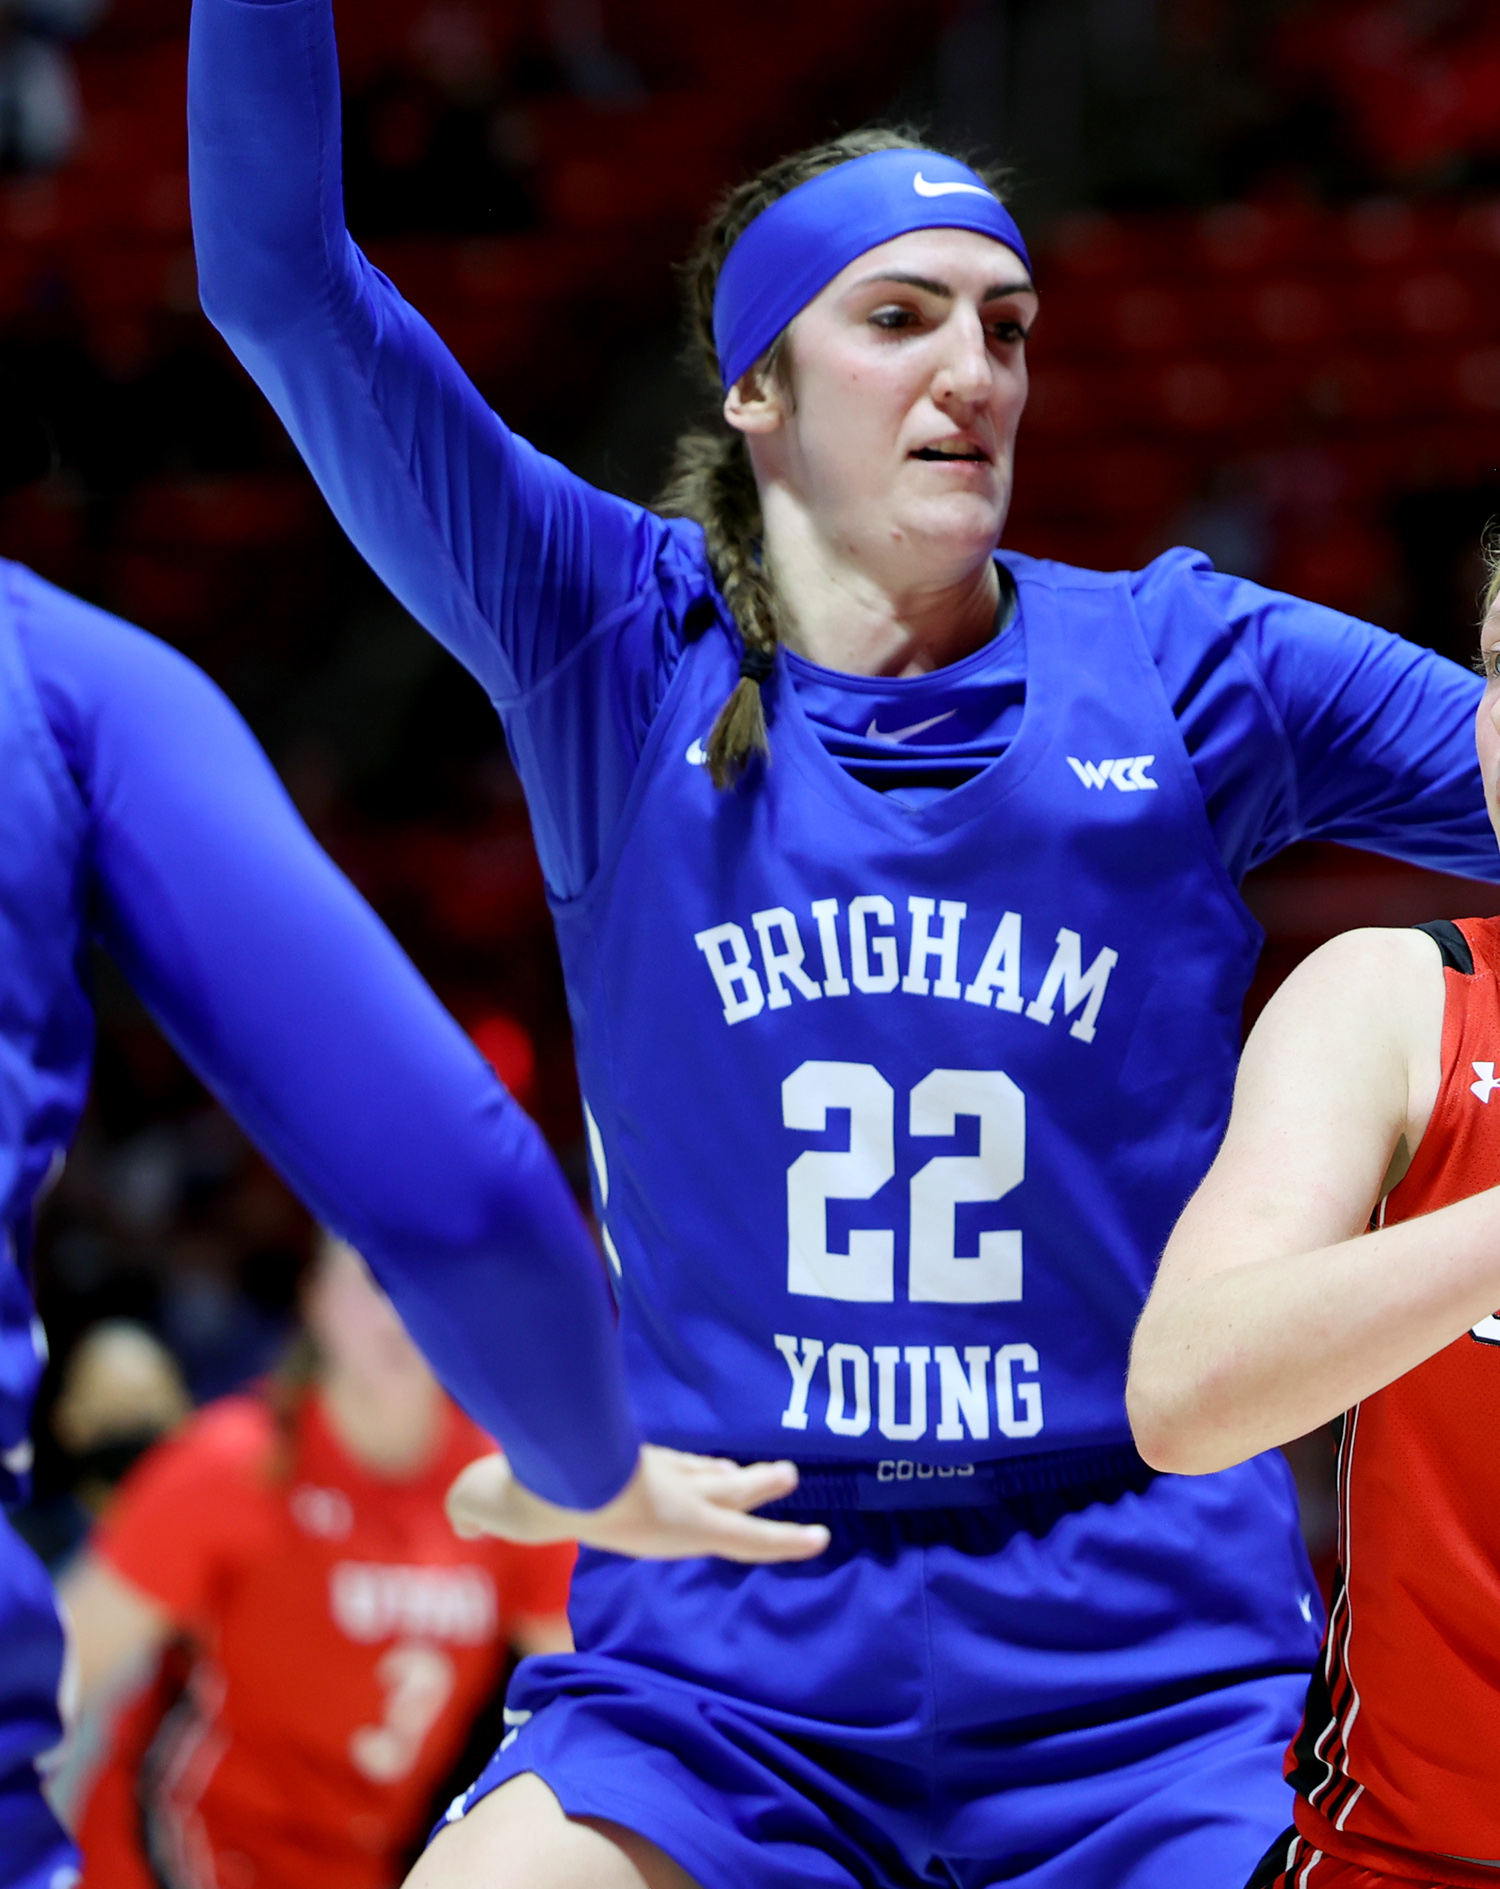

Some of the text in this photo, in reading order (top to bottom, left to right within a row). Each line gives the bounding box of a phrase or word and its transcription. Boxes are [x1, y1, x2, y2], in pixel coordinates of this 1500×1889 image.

[1066, 754, 1159, 792] WCC
[694, 894, 1119, 1043] BRIGHAM
[782, 1060, 1026, 1303] 22
[773, 1333, 1045, 1441] YOUNG
